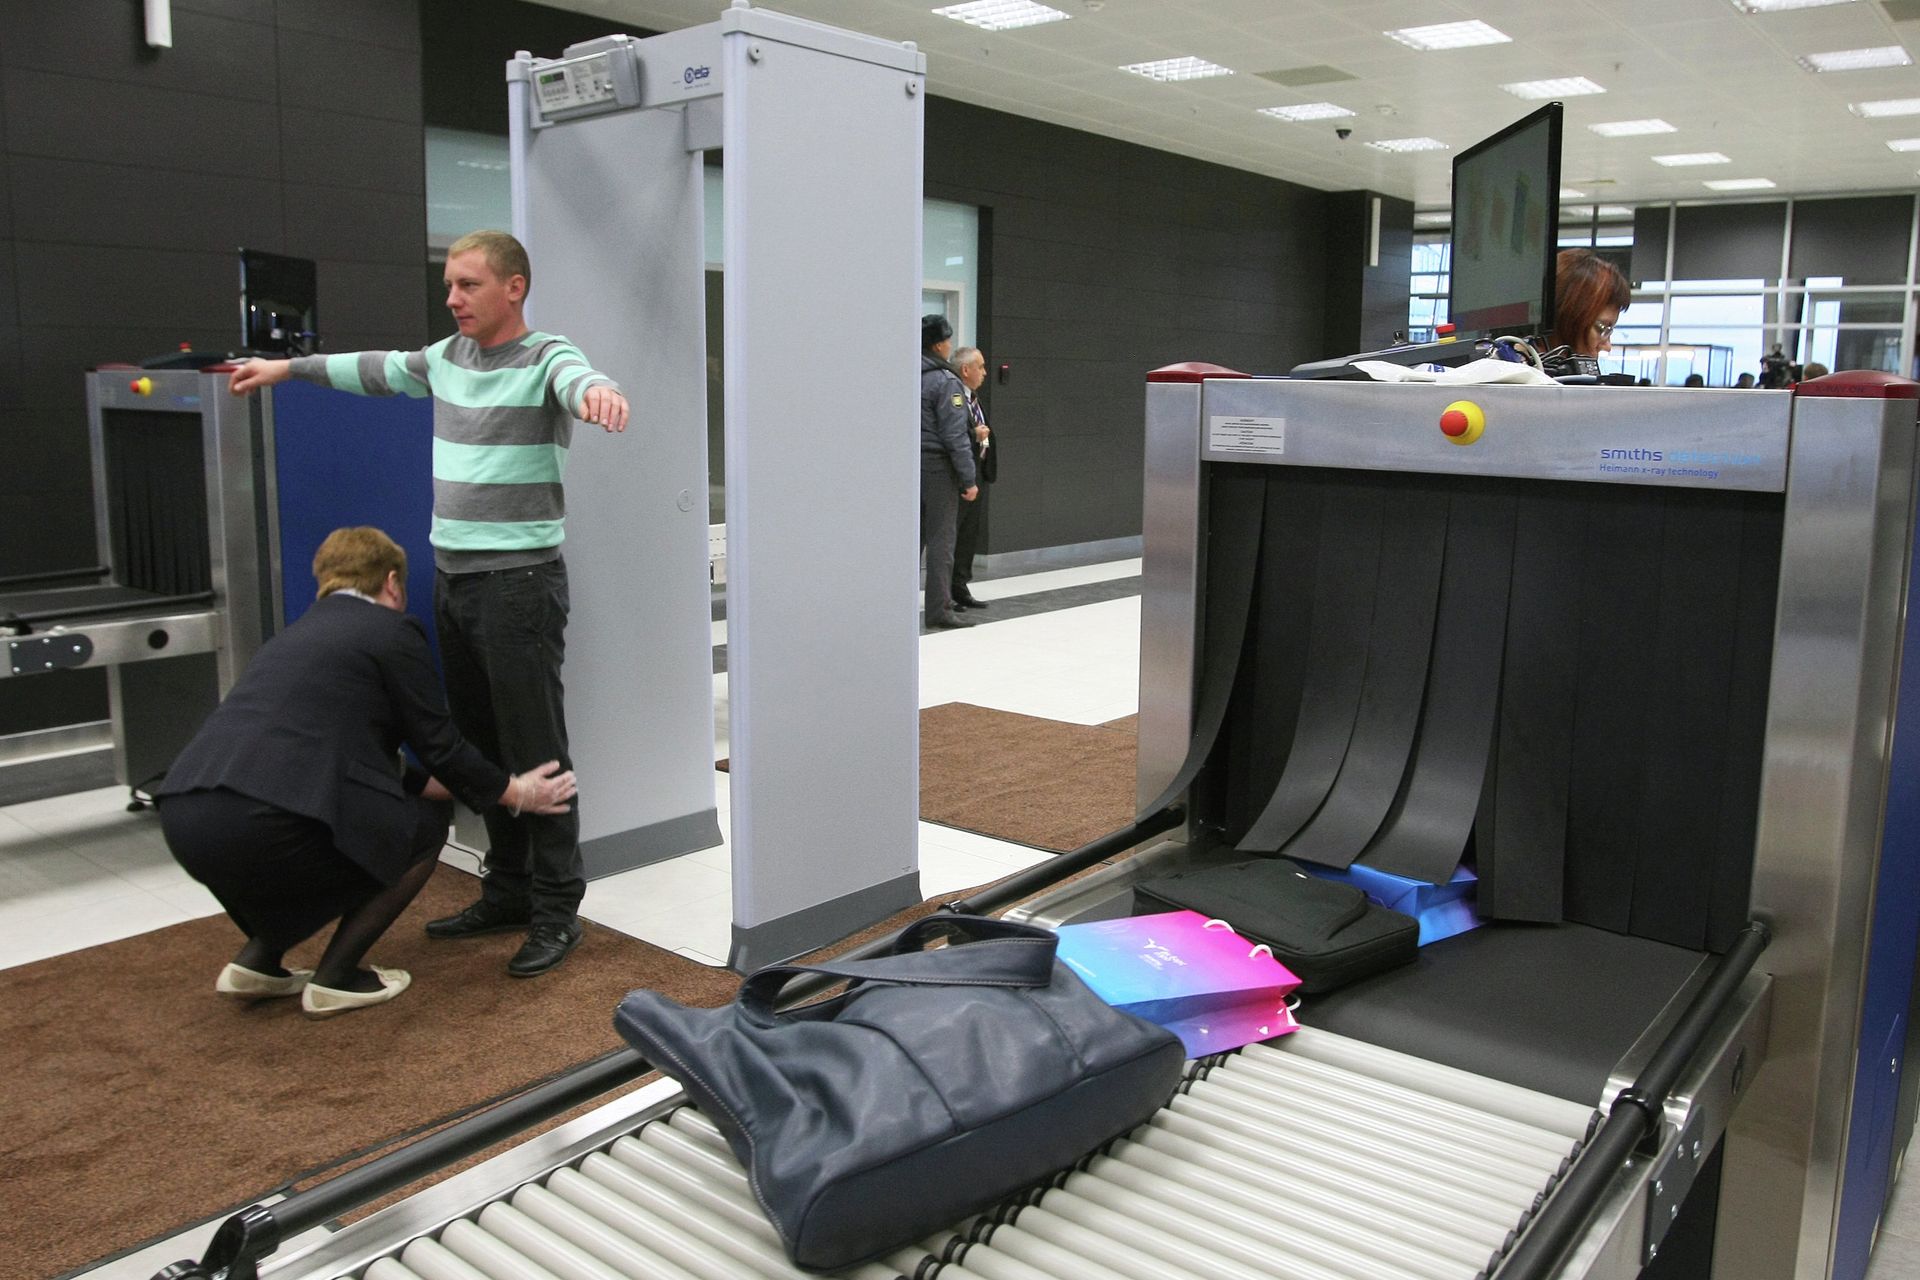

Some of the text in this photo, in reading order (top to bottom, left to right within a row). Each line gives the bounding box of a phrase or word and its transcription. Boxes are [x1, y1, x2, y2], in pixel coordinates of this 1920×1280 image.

[1601, 448, 1663, 462] smiths
[1600, 464, 1719, 479] Heimann x-ray technology
